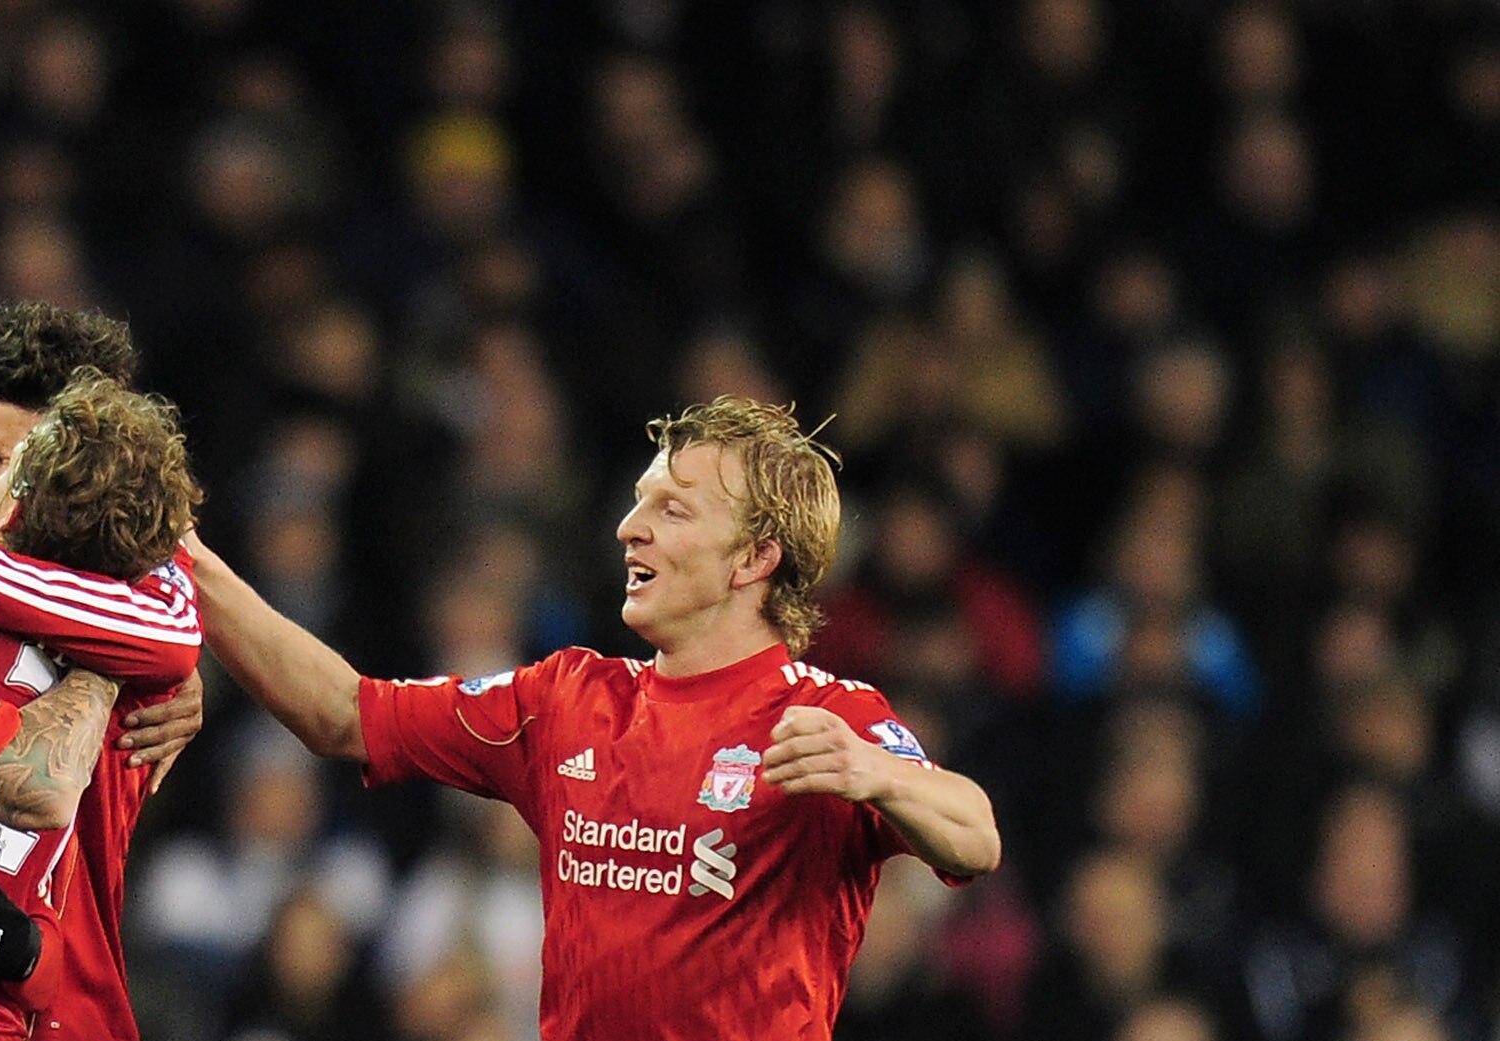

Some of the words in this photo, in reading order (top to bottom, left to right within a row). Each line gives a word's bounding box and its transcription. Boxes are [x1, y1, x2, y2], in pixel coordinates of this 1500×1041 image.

[557, 763, 596, 781] adidas
[563, 809, 687, 855] Standard
[558, 849, 683, 895] Chartered
